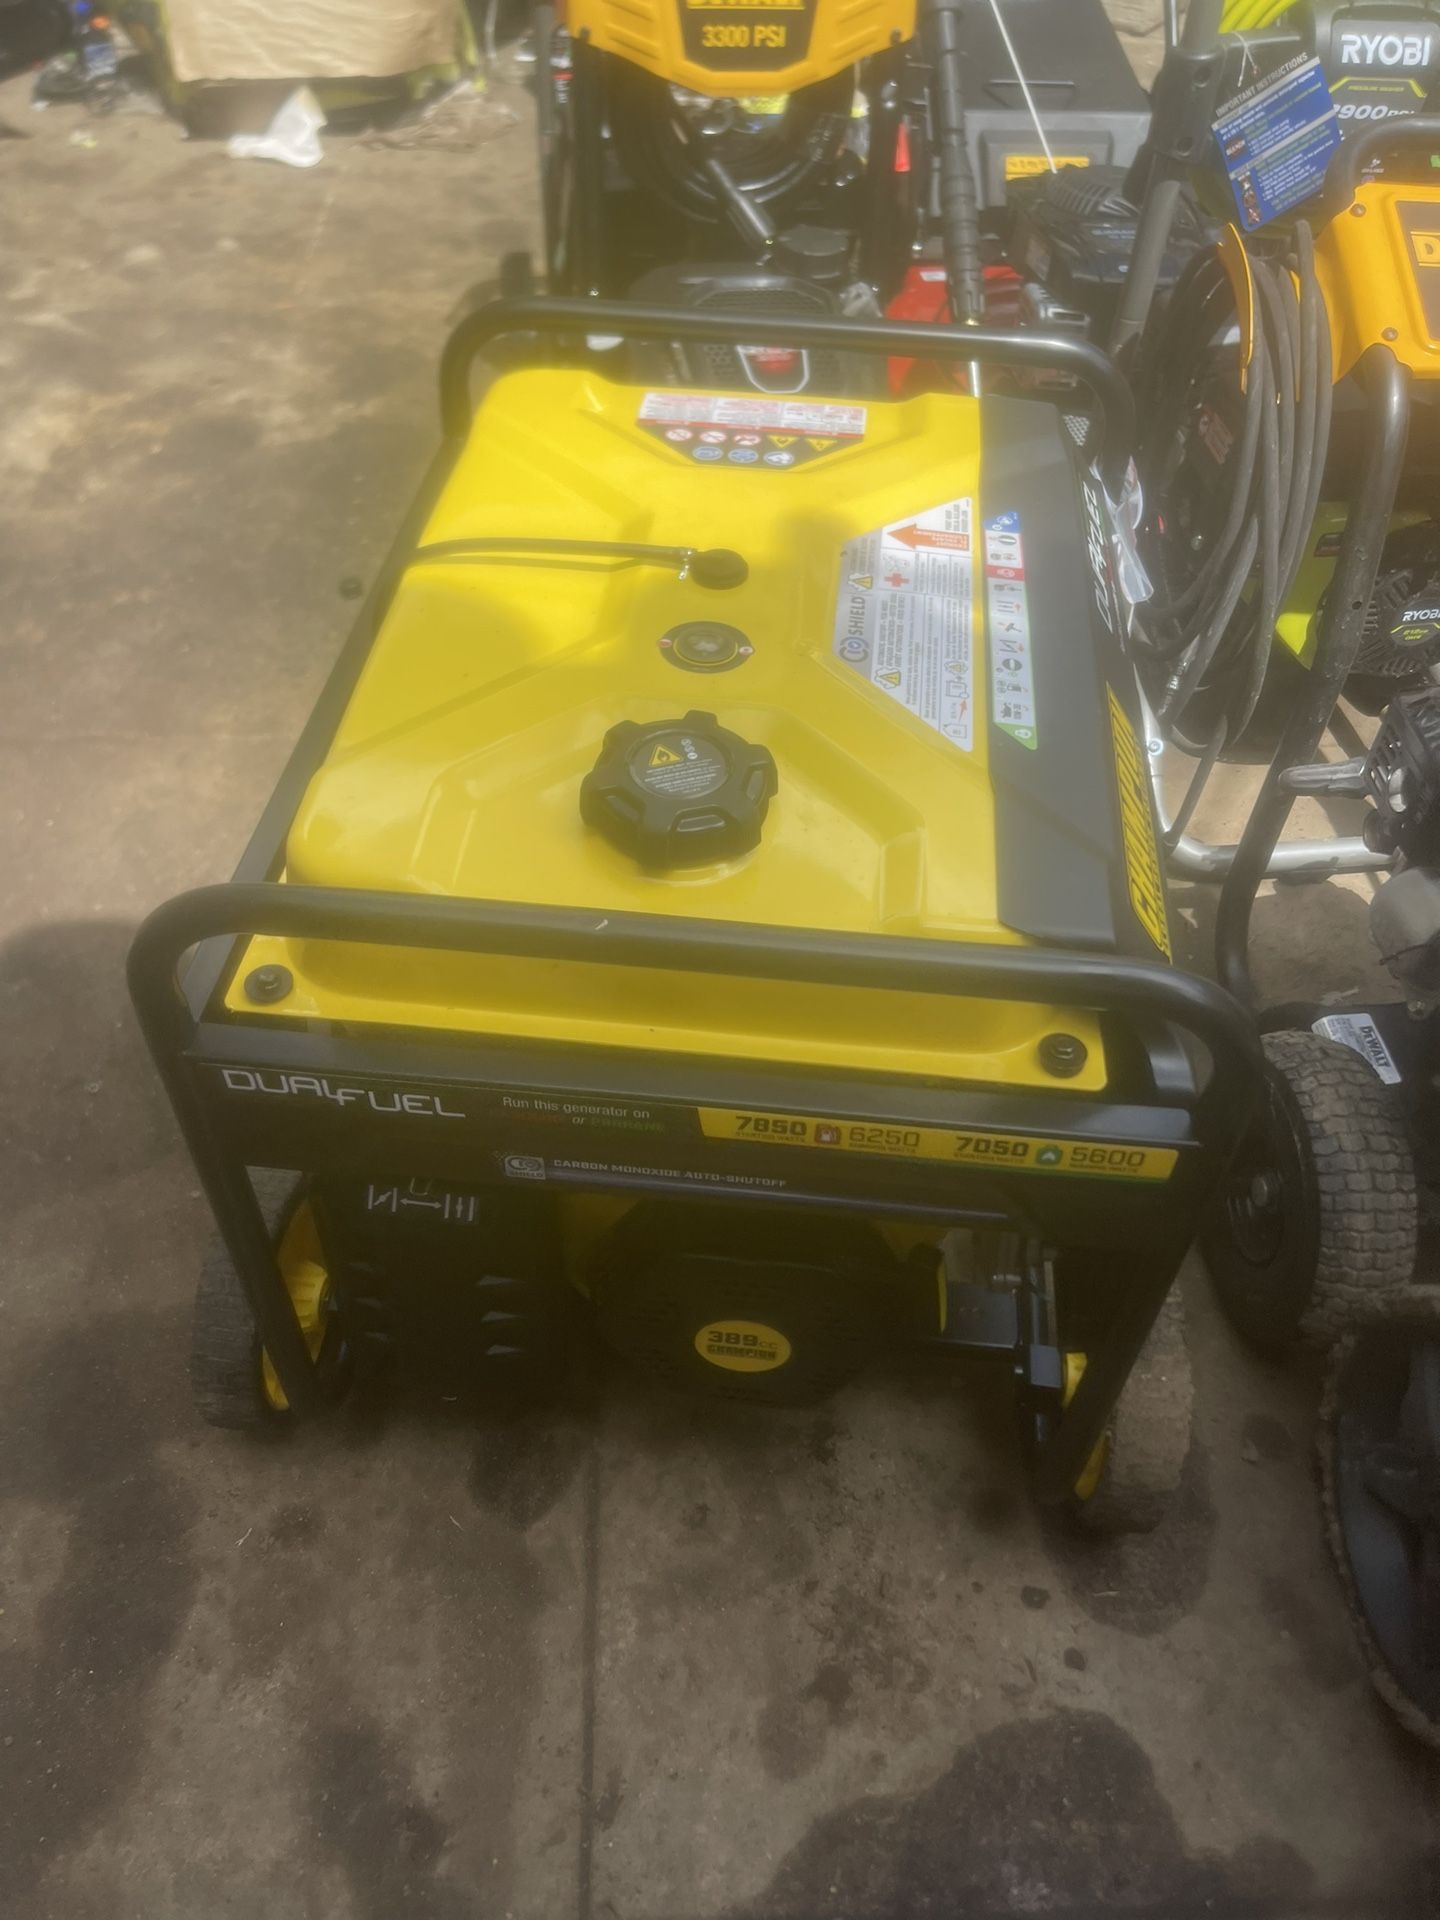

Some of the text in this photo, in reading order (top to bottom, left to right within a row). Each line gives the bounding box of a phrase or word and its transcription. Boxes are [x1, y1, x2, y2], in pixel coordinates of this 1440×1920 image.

[702, 25, 786, 48] 3300 PSI
[1341, 33, 1431, 66] RYOBI
[1216, 85, 1257, 117] IMPORTANT
[848, 596, 866, 636] SHIELD
[502, 1097, 650, 1119] Run this generator on
[572, 1116, 585, 1125] or
[735, 1115, 920, 1147] 7850 6250
[956, 1136, 1146, 1168] 7050 5600
[553, 1159, 787, 1188] CARBON MONOXIDE AUTO-SHUTOFF
